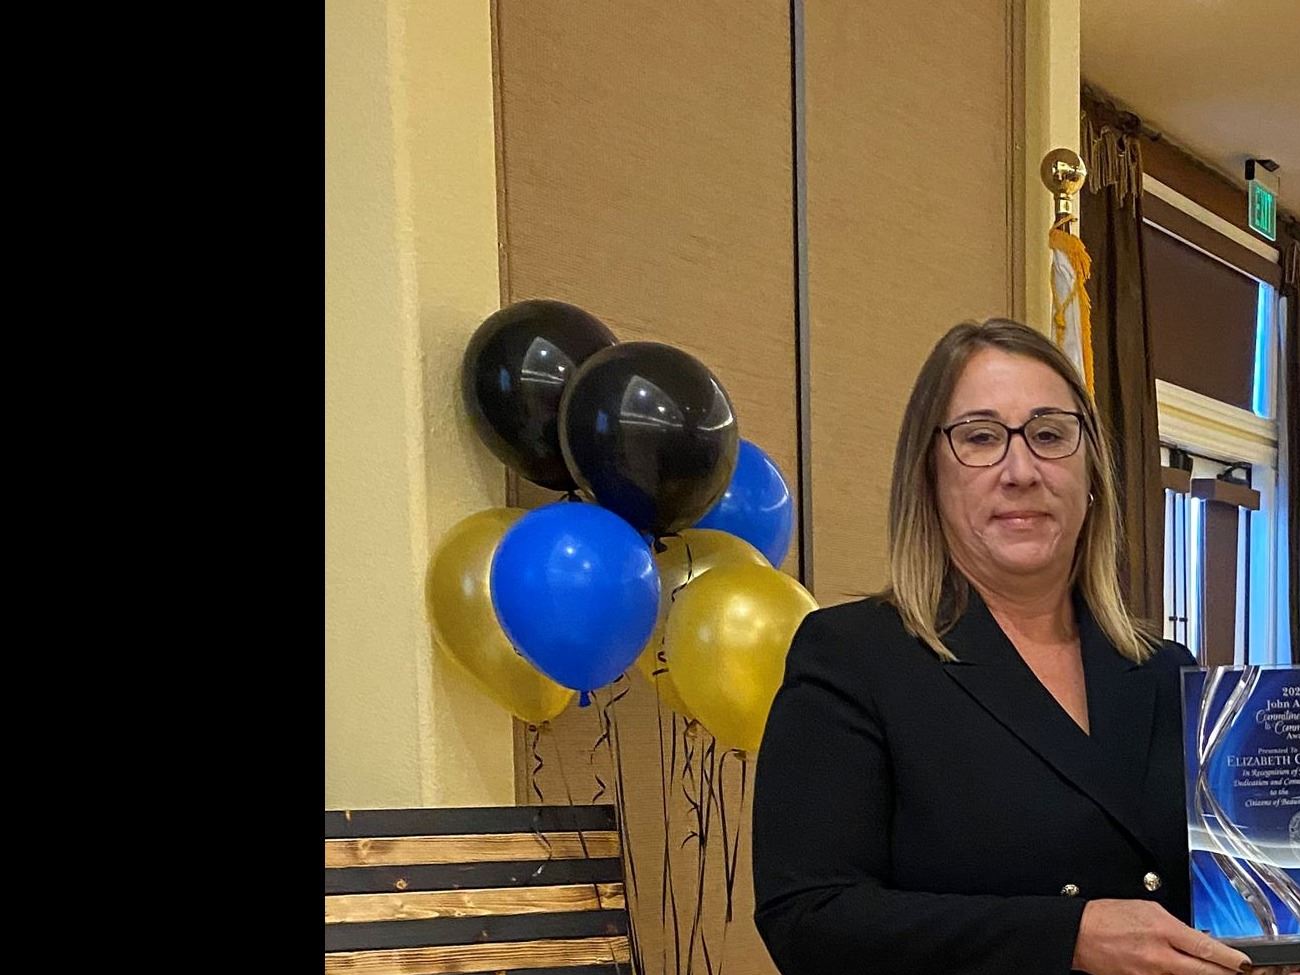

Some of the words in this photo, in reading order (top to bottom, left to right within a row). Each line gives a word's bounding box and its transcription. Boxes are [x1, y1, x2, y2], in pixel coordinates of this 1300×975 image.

[1255, 186, 1273, 233] EXIT
[1265, 699, 1290, 711] John
[1227, 755, 1290, 767] ELIZABETH
